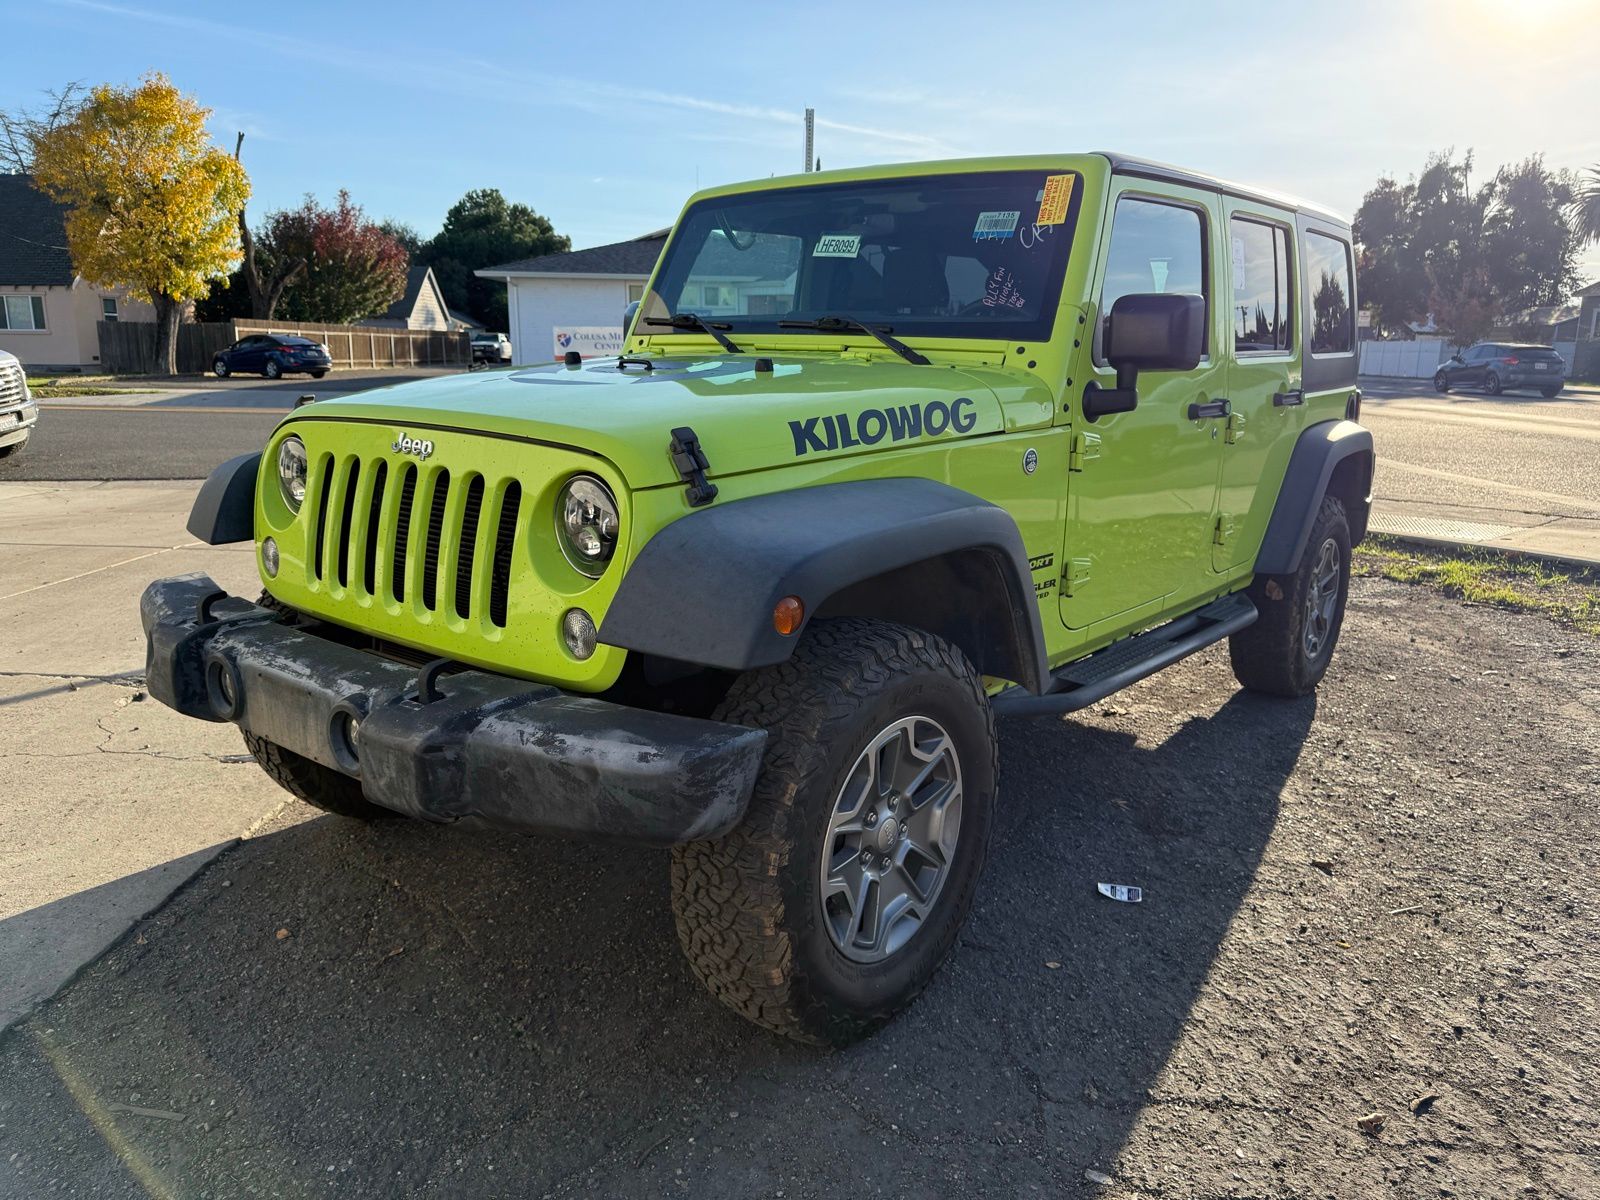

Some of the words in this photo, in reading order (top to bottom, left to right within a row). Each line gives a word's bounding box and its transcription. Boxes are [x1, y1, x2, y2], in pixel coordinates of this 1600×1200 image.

[1042, 178, 1054, 207] VEHICLE
[821, 239, 855, 252] HF8099
[787, 397, 977, 457] KILOWOG
[391, 432, 434, 461] Jeep
